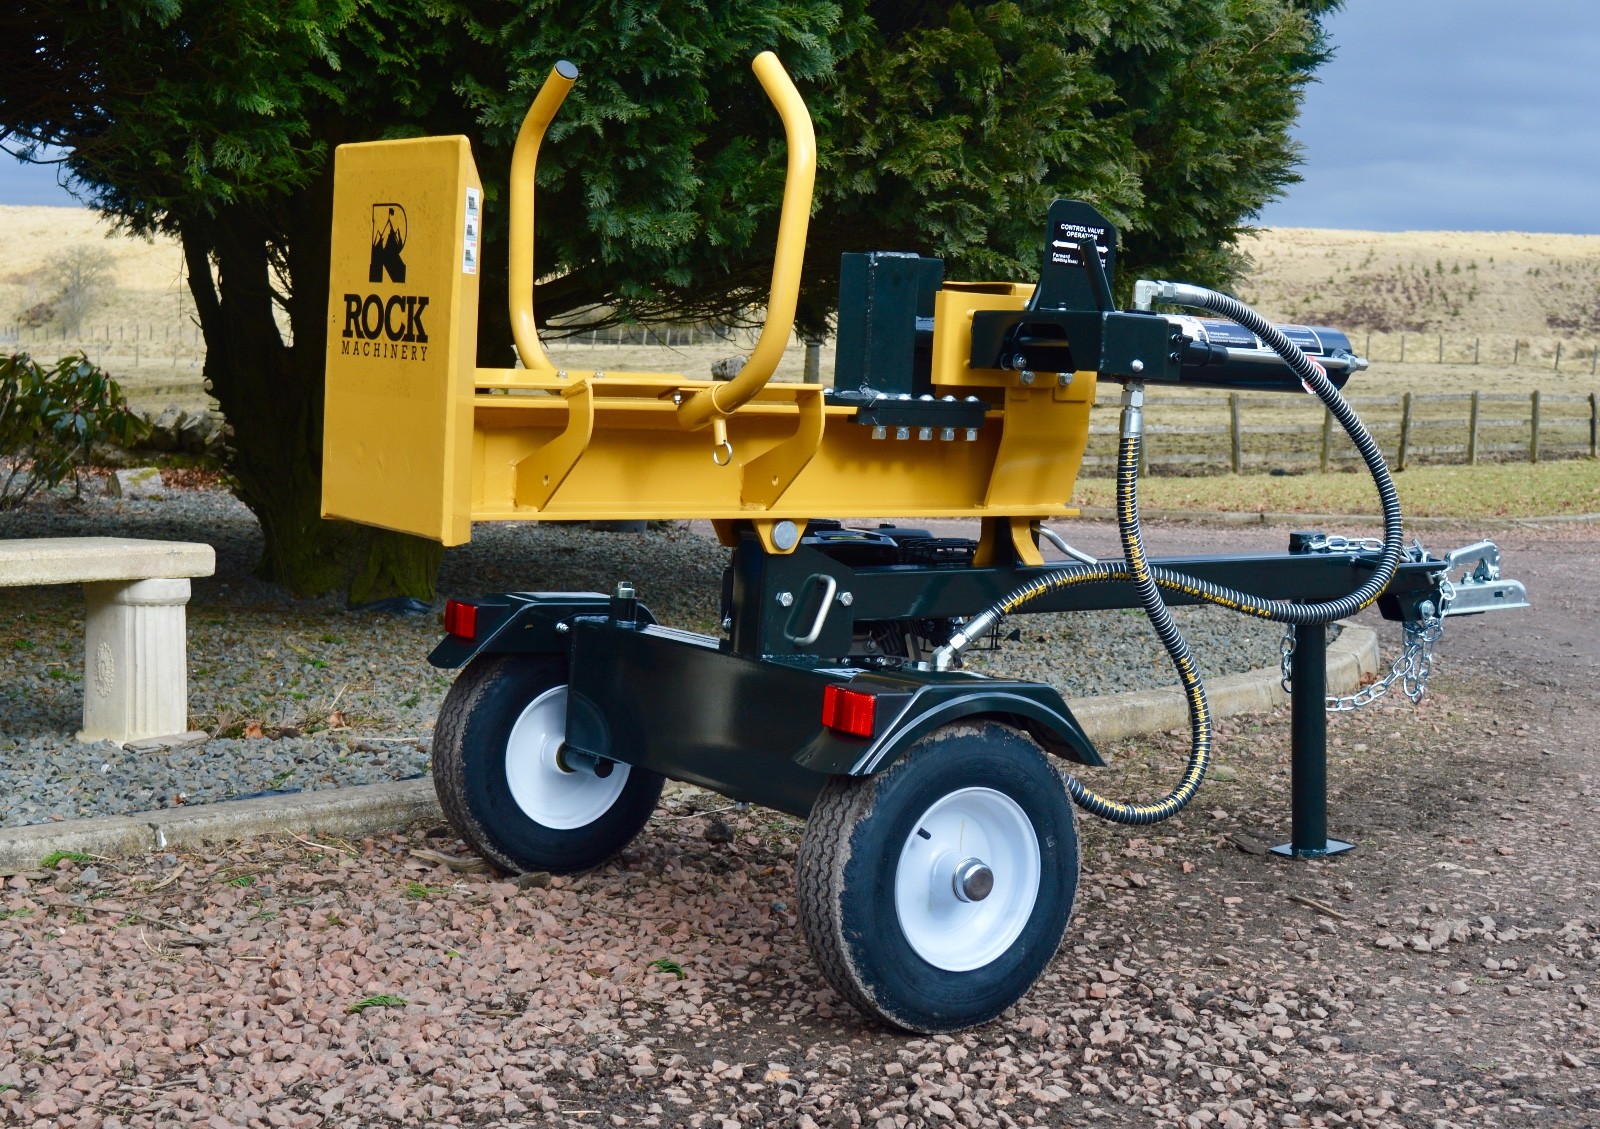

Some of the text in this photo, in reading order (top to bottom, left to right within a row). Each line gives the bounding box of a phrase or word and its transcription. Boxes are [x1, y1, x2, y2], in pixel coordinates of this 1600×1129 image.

[1060, 223, 1105, 235] CONTROL VALVE
[1066, 231, 1098, 240] OPERATION
[342, 293, 429, 344] ROCK
[341, 340, 428, 361] MACHINERY
[1056, 572, 1108, 587] HYDRAULIC
